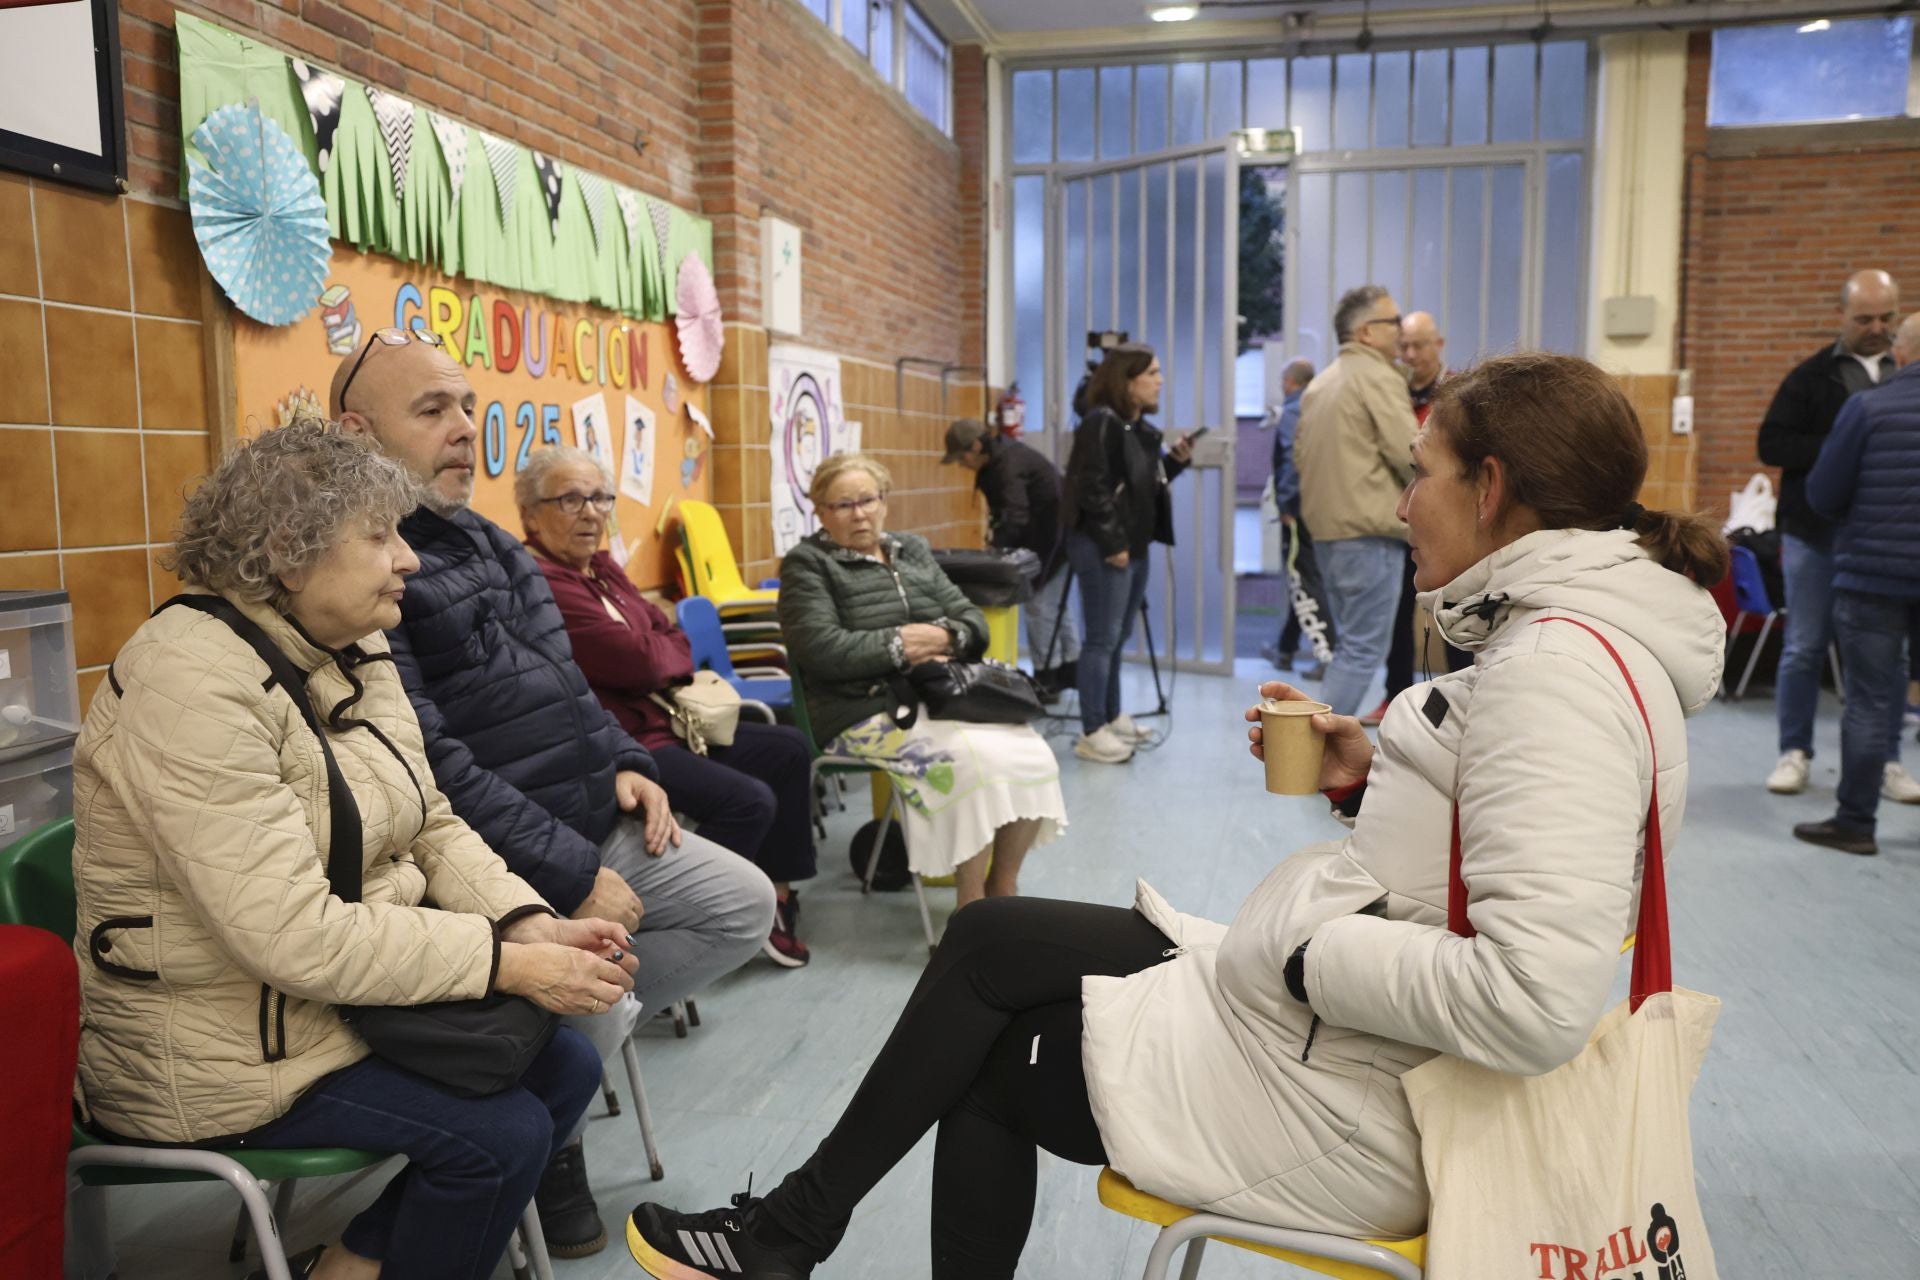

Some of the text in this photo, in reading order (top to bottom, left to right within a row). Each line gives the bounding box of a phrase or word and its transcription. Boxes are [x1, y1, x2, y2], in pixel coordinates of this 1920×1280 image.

[482, 400, 561, 478] 025
[1289, 569, 1334, 664] adidas
[1530, 1225, 1647, 1280] TRAIL
